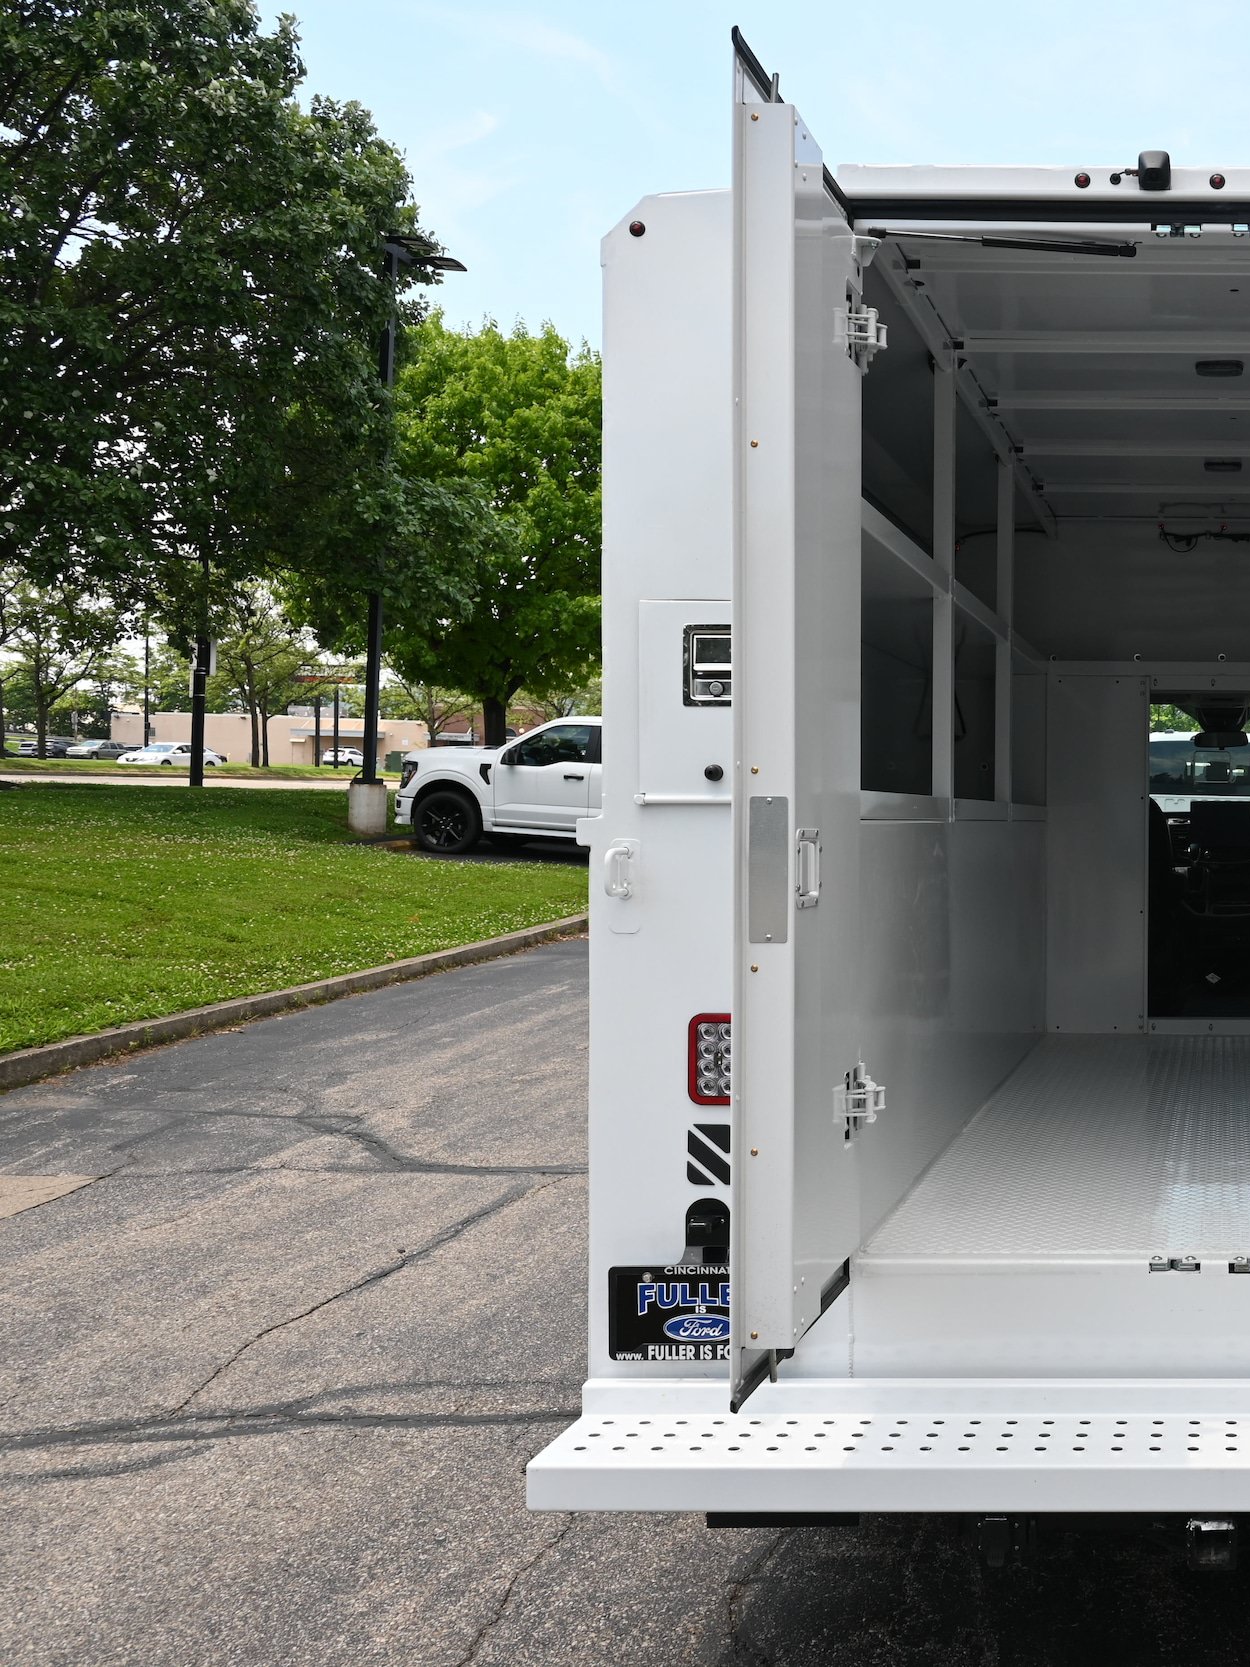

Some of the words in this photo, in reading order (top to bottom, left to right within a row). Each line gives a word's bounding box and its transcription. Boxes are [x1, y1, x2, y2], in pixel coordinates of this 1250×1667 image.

[695, 1306, 707, 1314] IS
[679, 1319, 723, 1337] Ford
[648, 1345, 695, 1360] FULLER
[700, 1345, 713, 1360] IS
